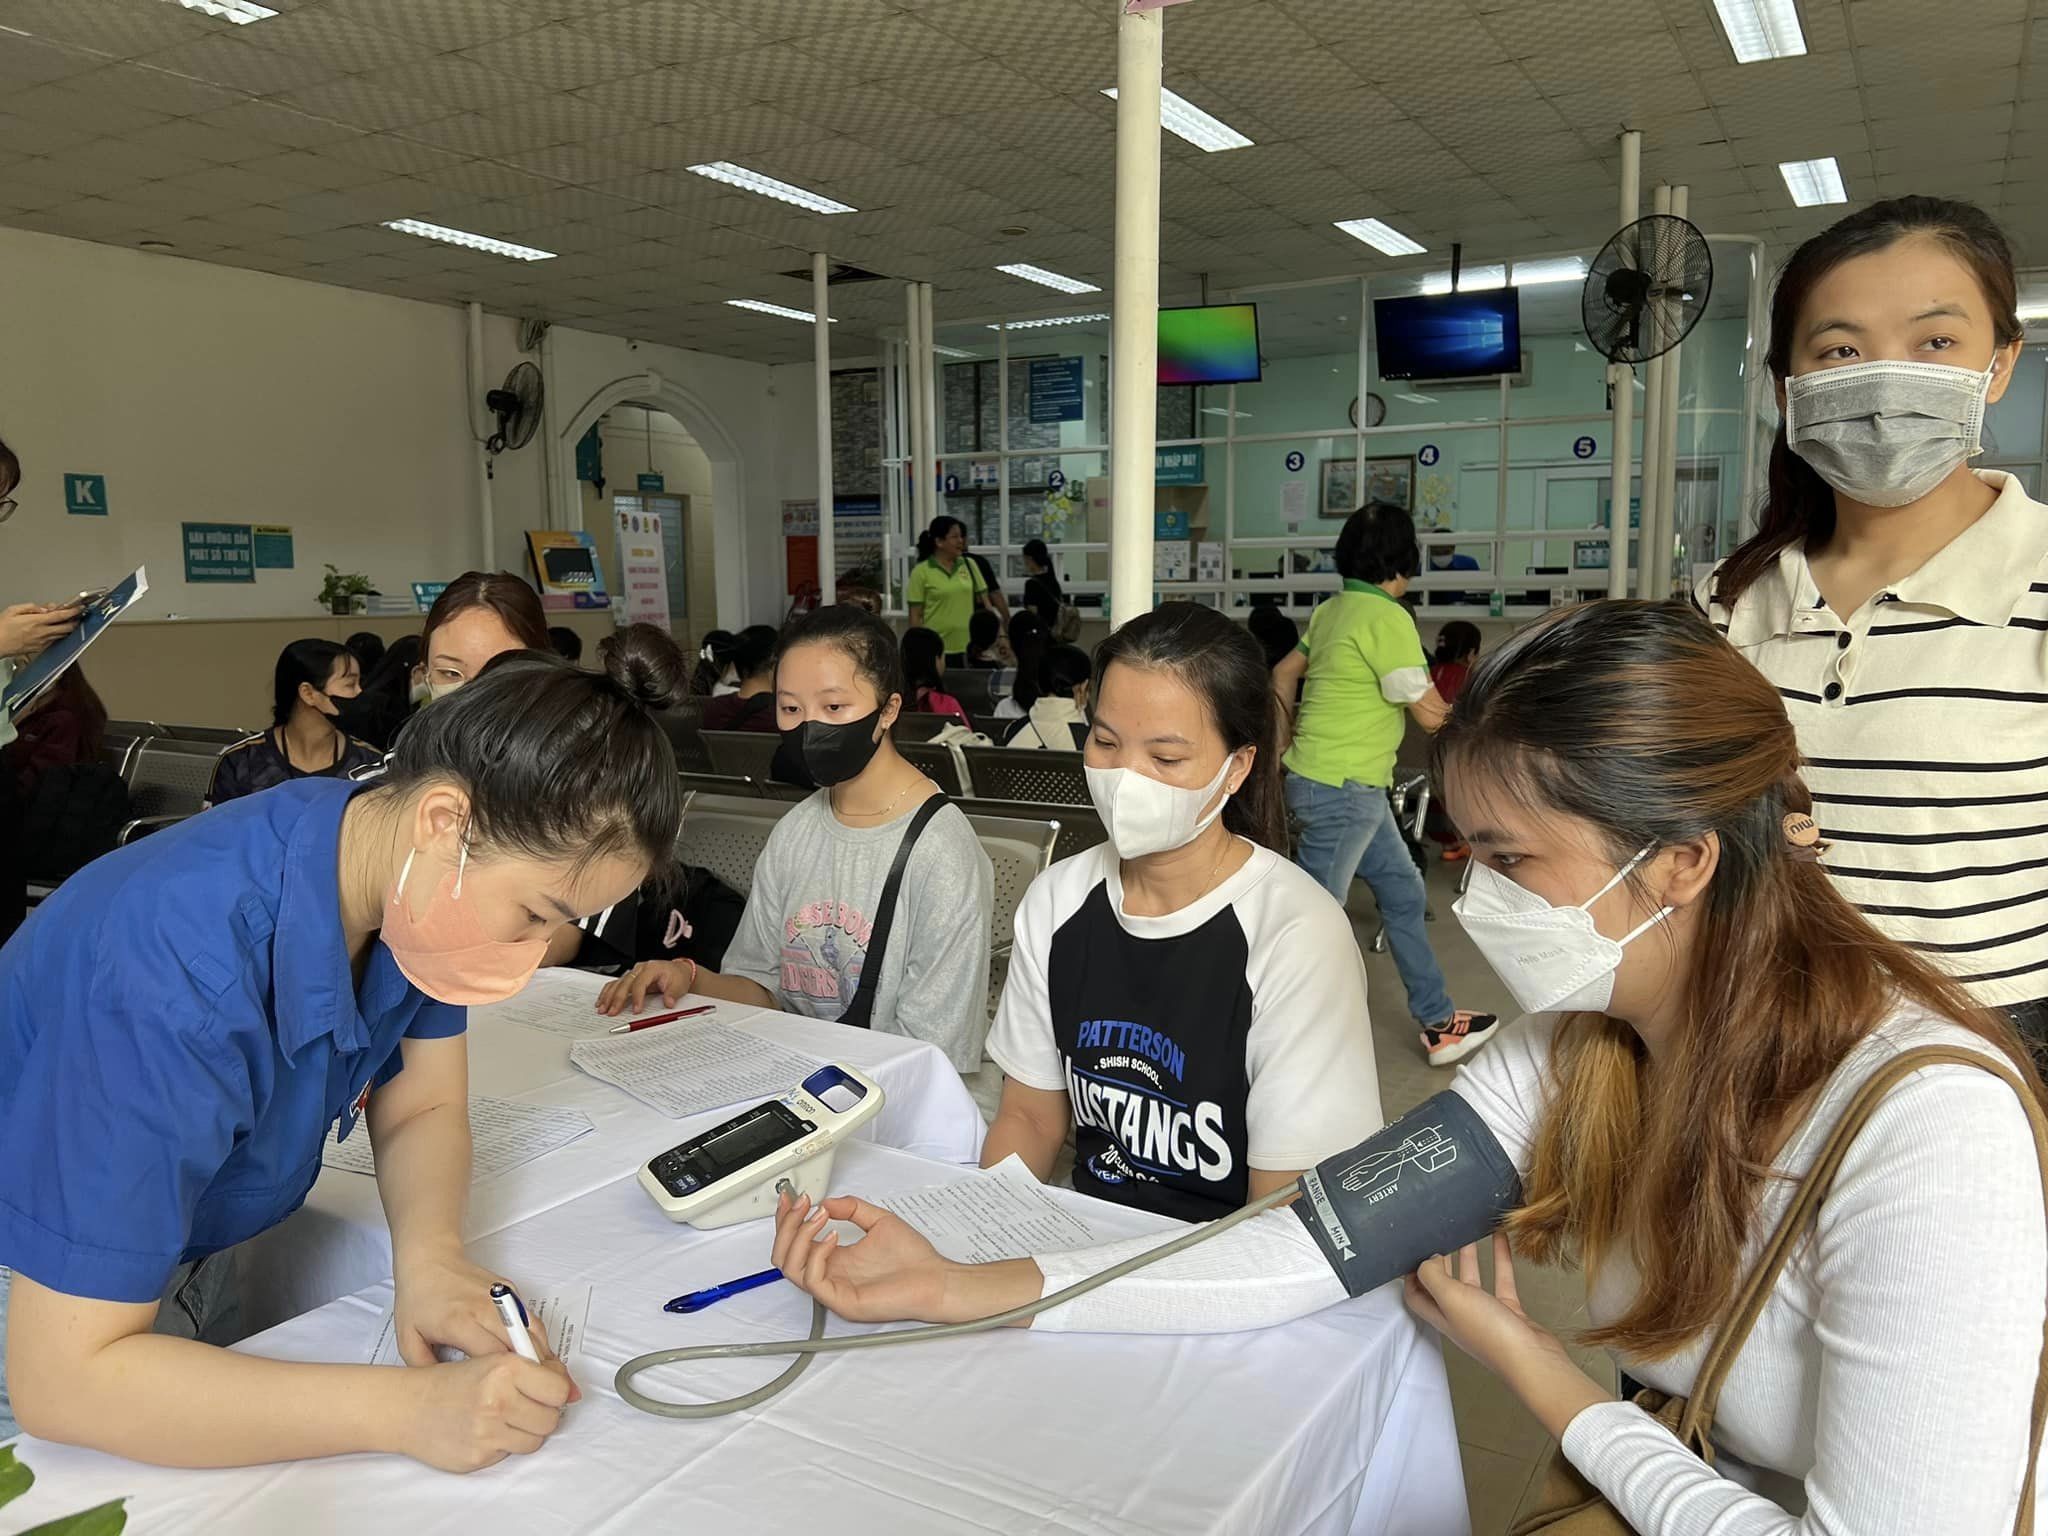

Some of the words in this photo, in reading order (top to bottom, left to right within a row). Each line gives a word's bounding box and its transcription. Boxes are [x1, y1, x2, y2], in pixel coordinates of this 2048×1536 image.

[1420, 447, 1435, 463] 4
[1578, 440, 1592, 456] 5
[1288, 454, 1301, 470] 3
[947, 477, 957, 491] 1
[1051, 472, 1062, 487] 2
[75, 479, 97, 504] K
[1077, 1020, 1186, 1083] PATTERSON
[1131, 1058, 1160, 1086] SCHOOL
[1100, 1144, 1119, 1165] 20
[1367, 1183, 1399, 1206] ARTERY
[1330, 1226, 1345, 1245] MIN
